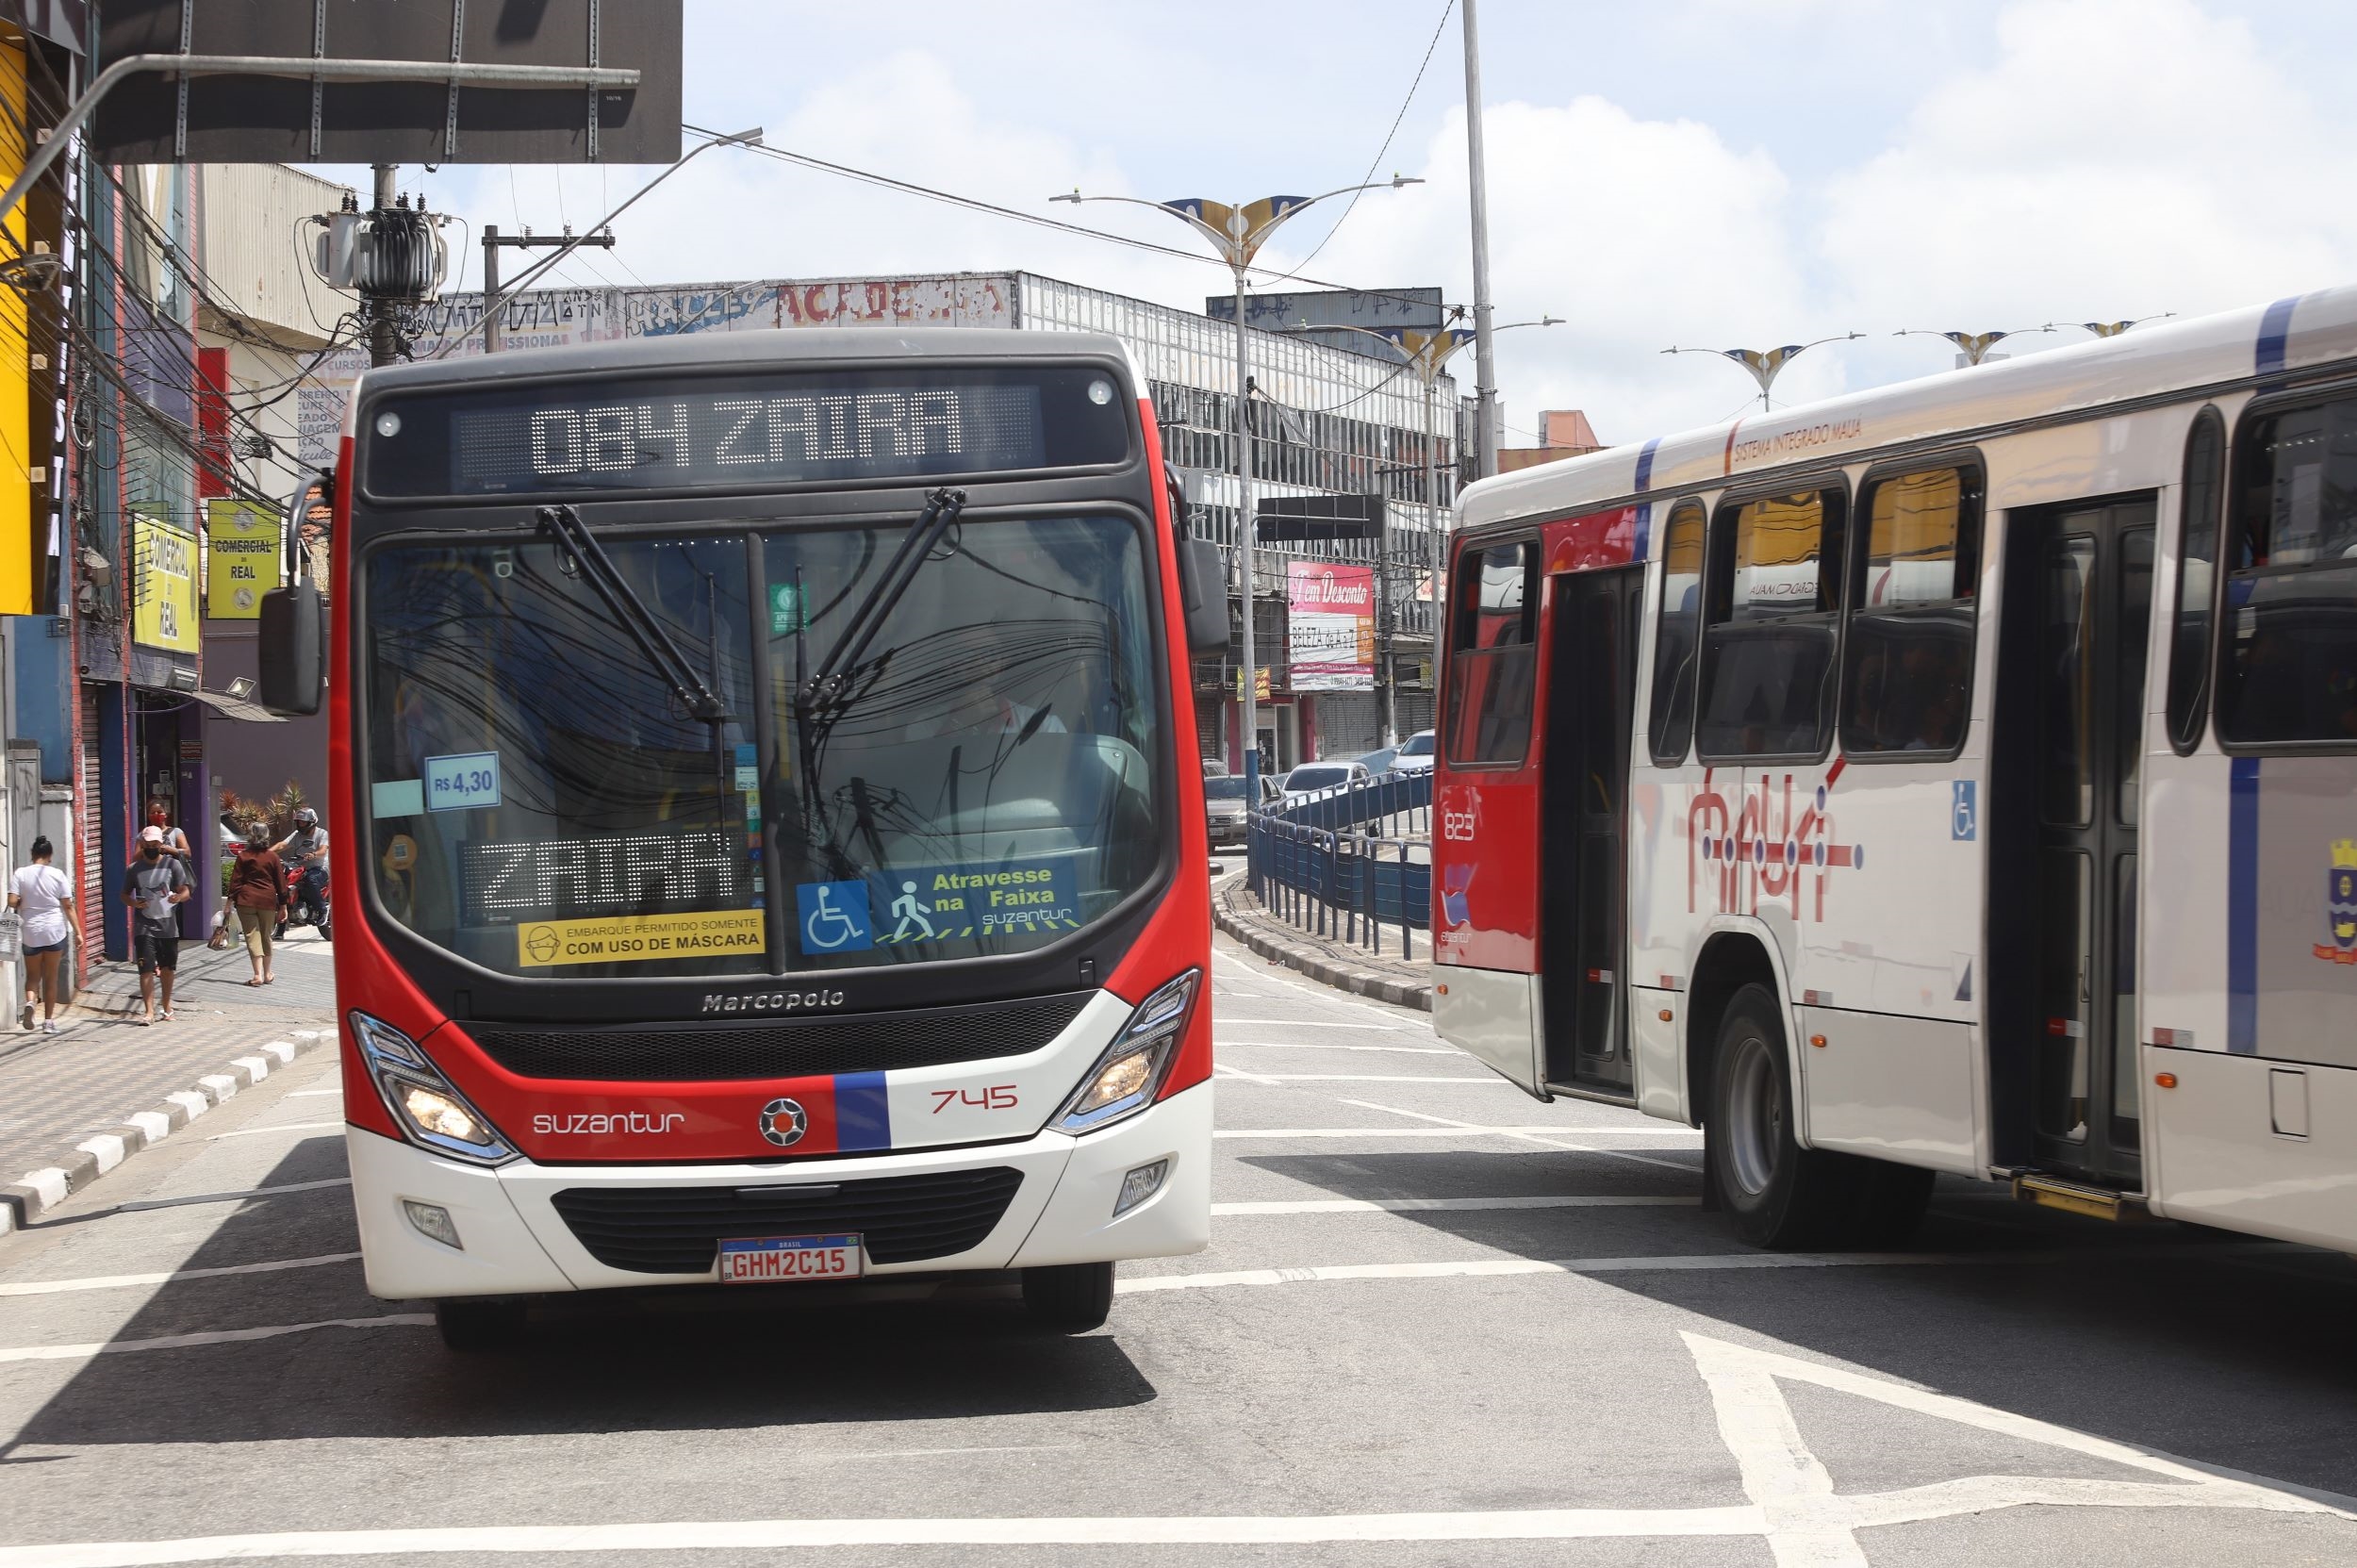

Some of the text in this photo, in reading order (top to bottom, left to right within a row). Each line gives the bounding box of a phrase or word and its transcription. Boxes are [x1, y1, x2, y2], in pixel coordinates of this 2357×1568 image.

[327, 359, 371, 371] CURSOS
[531, 390, 962, 474] 084 ZAIRA
[1734, 412, 1863, 462] SISTEMA INTEGRADO MAUÁ
[149, 530, 190, 581] COMERCIAL
[215, 539, 272, 554] COMERCIAL
[231, 566, 255, 580] REAL
[1322, 570, 1368, 604] Desconto
[159, 601, 178, 641] REAL
[1293, 627, 1322, 648] BELEZA
[453, 769, 493, 796] 4,30
[1444, 813, 1475, 841] 823
[481, 833, 733, 909] ZAIRA
[932, 868, 1052, 891] Atravesse
[935, 888, 1055, 912] na Faixa
[567, 917, 758, 938] EMBARQUE PERMITIDO SOMENTE
[982, 908, 1072, 926] suzantur
[567, 933, 759, 955] COM USO DE MÁSCARA
[701, 989, 844, 1013] Marcopolo
[931, 1084, 1018, 1114] 745
[533, 1112, 684, 1134] suzantur
[733, 1248, 846, 1278] GHM2C15
